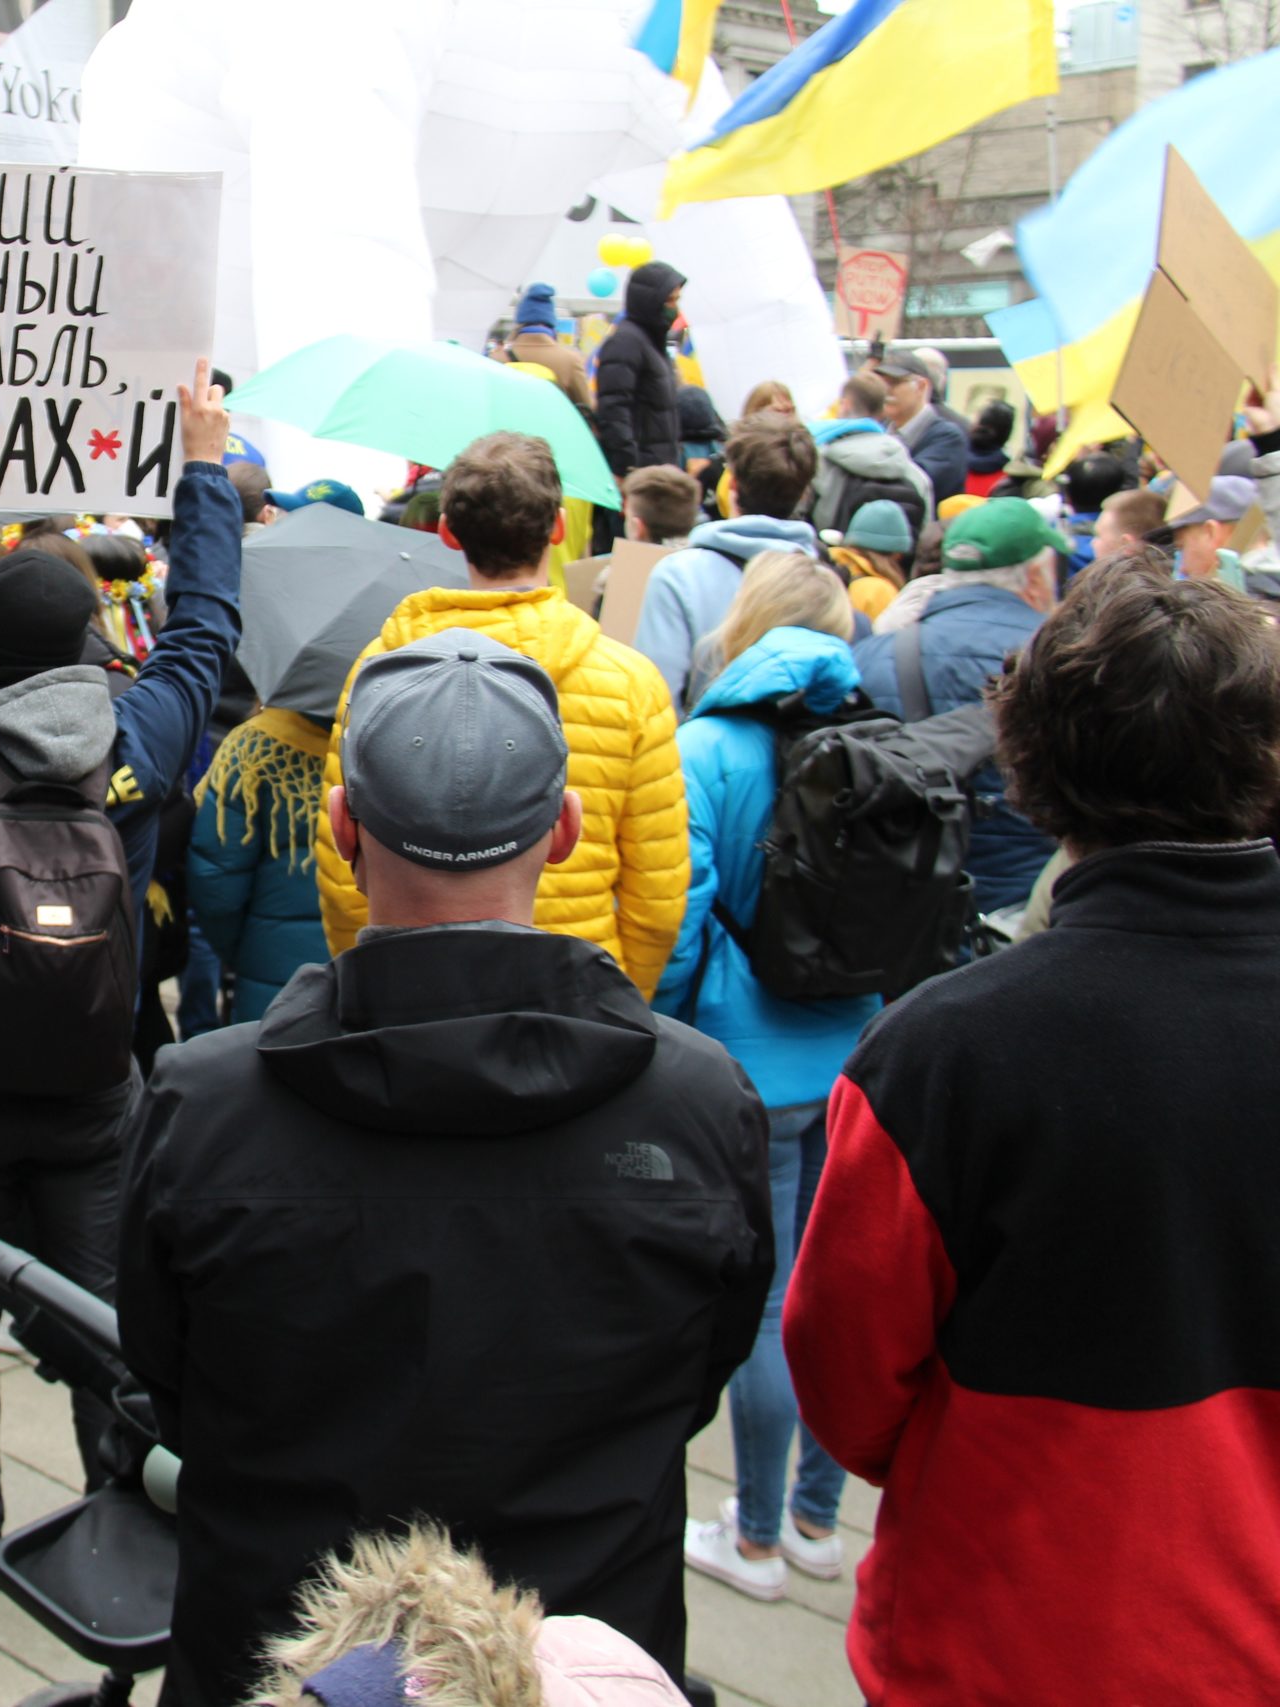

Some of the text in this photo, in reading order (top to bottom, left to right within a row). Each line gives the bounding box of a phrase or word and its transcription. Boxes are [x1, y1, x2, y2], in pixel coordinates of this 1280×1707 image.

[403, 841, 518, 861] UNDER ARMOUR
[625, 1142, 650, 1154] THE
[604, 1153, 651, 1166] NORTH
[617, 1166, 652, 1179] FACE
